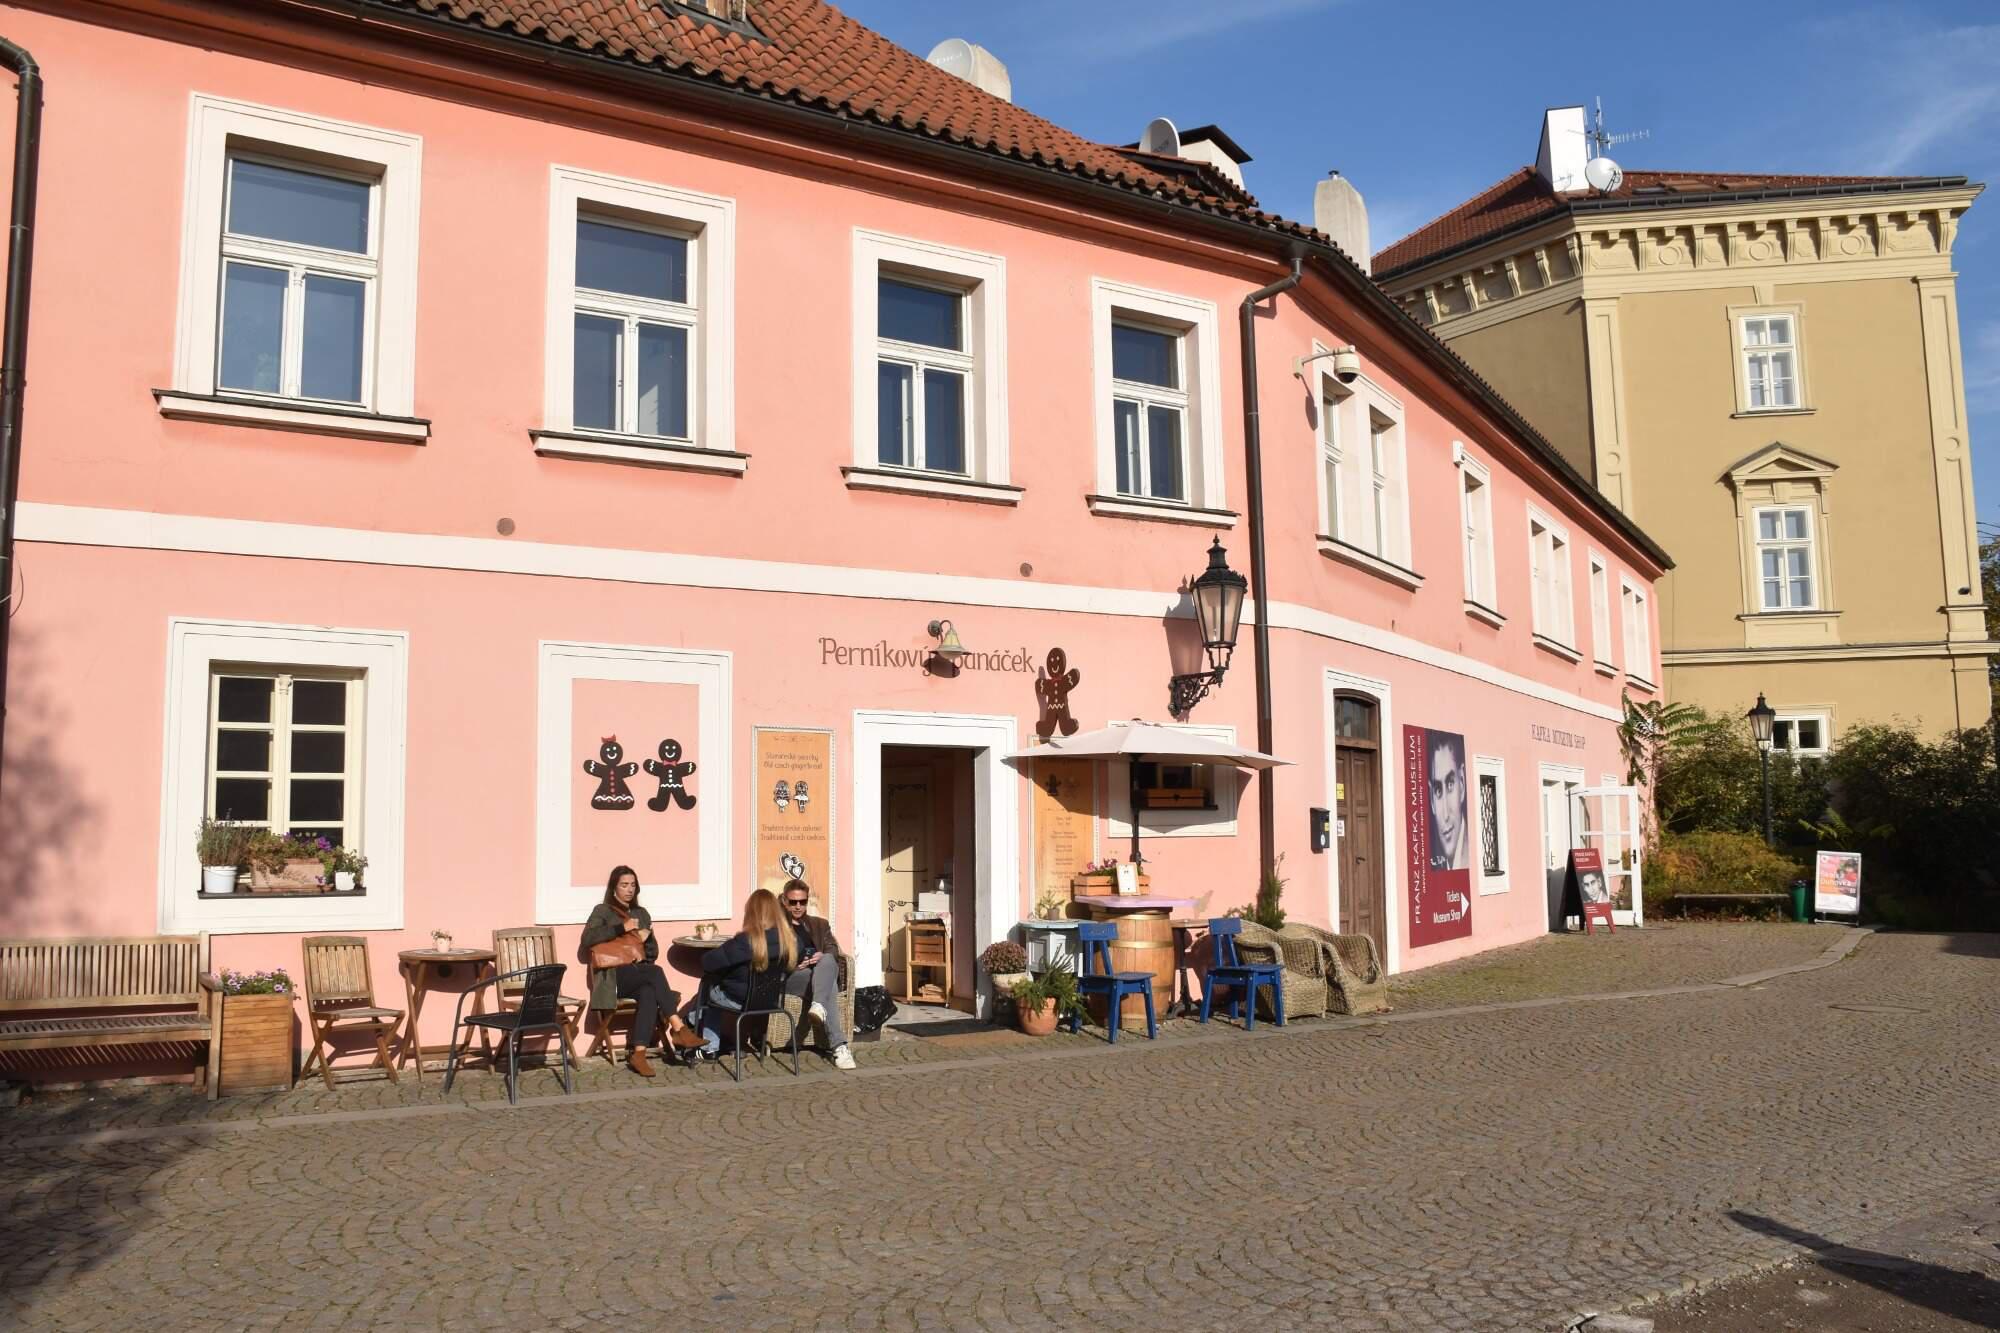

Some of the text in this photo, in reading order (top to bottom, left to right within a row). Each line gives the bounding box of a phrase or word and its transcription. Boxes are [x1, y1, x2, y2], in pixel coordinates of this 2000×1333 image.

[818, 637, 932, 676] Perníkový
[1531, 723, 1551, 743] KAFKA
[1409, 735, 1418, 806] MUSEUM
[1412, 810, 1420, 865] KAFKA
[1433, 909, 1461, 926] Museum Shop
